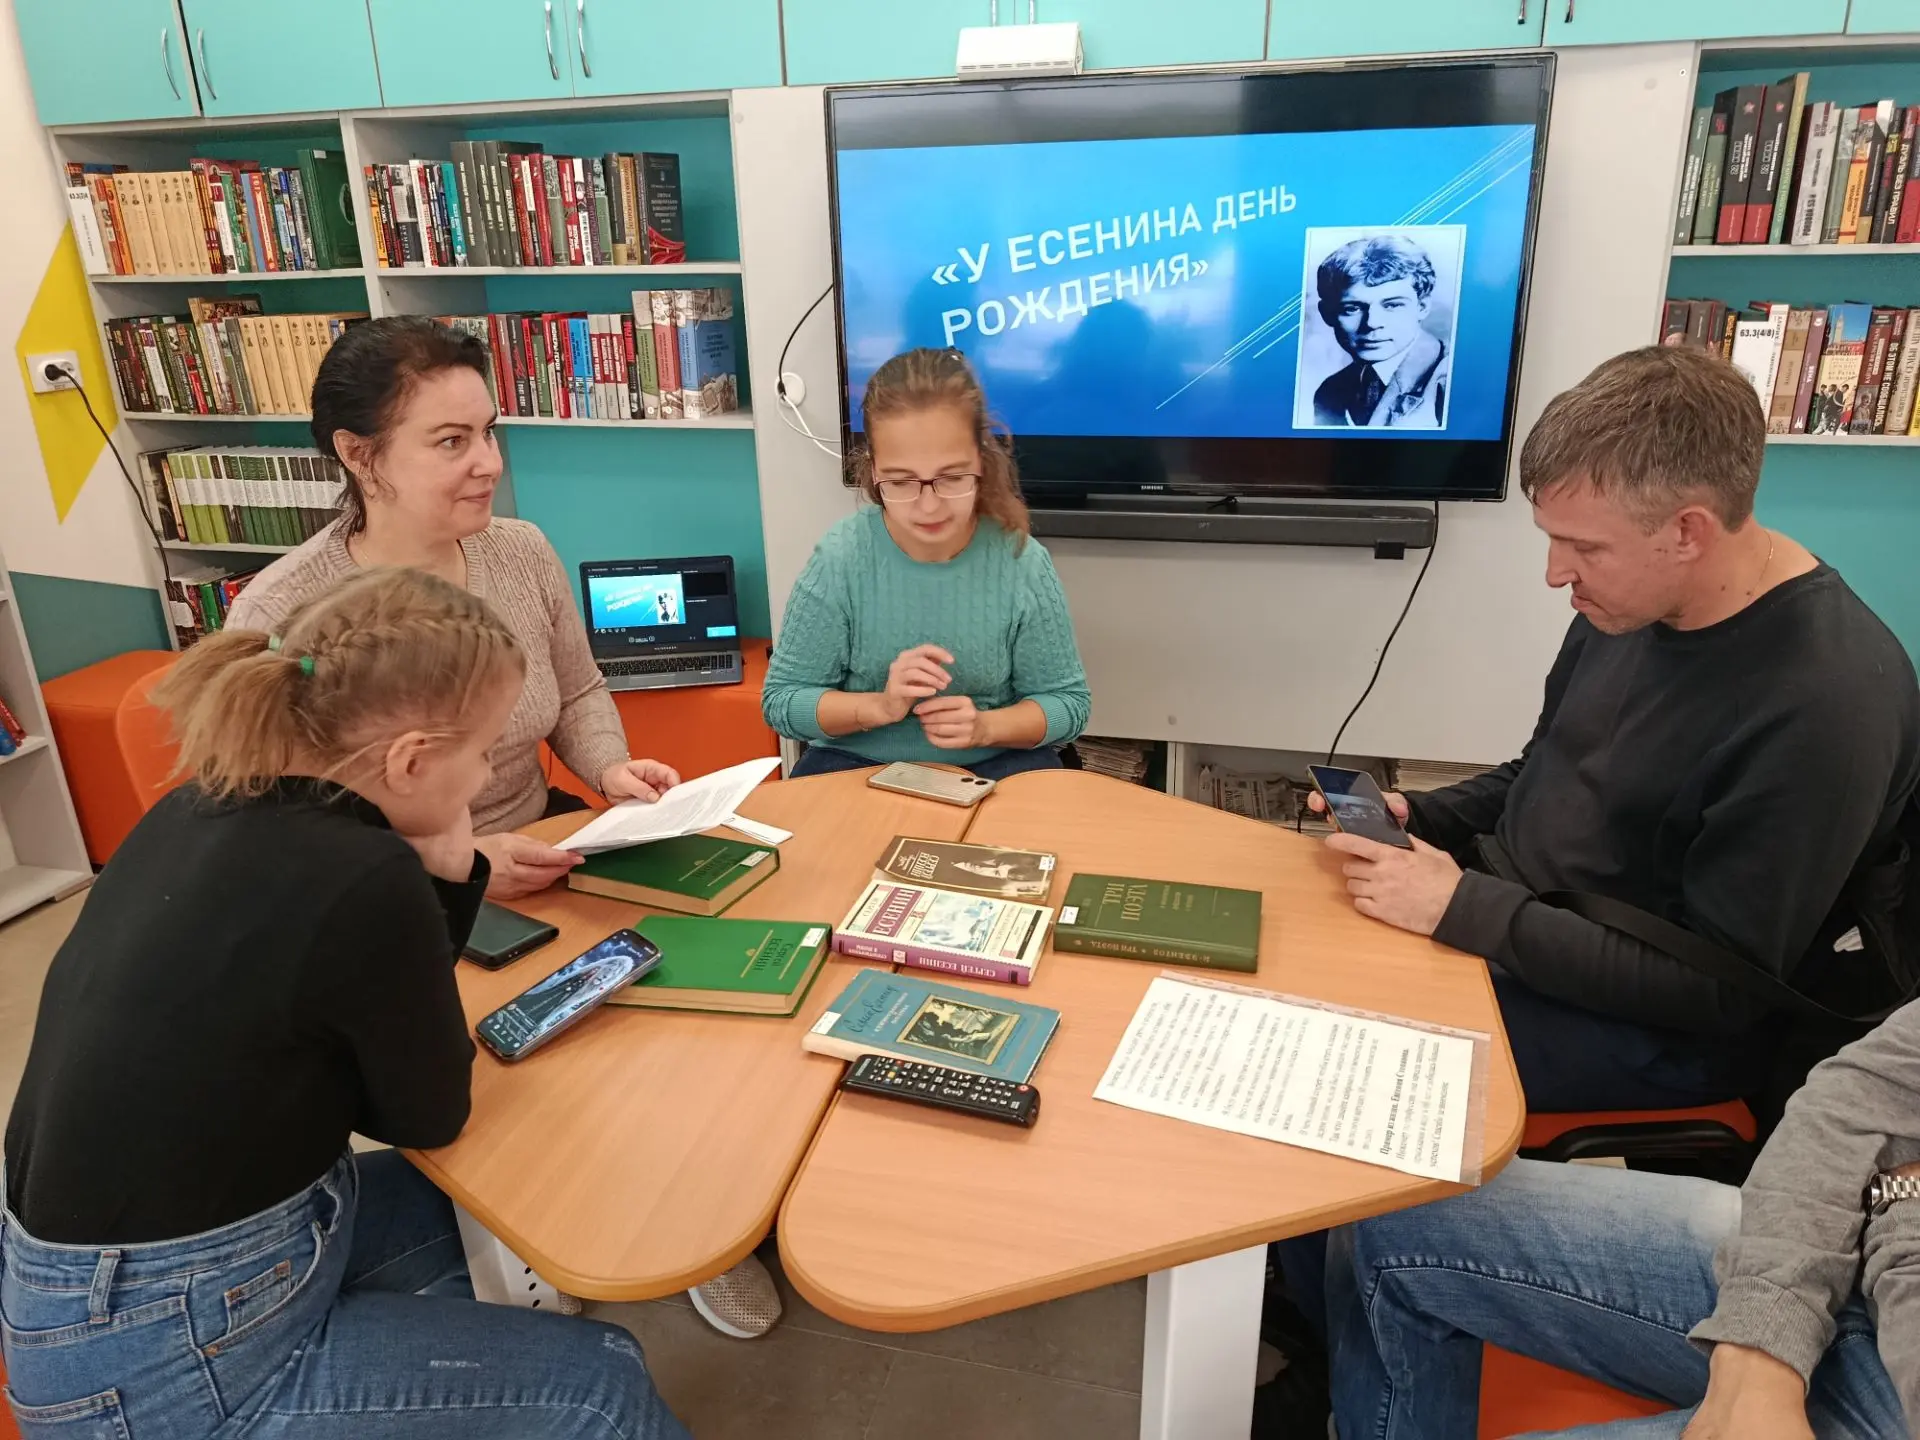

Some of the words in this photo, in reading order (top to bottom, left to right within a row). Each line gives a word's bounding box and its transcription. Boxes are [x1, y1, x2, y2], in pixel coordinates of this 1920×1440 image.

[1896, 143, 1909, 173] ДУЭЛЬ
[1894, 173, 1903, 190] БЕЗ
[1887, 190, 1900, 225] ПРАВИЛ
[932, 243, 990, 286] «У
[1007, 202, 1202, 274] ЕСЕНИНА
[1212, 184, 1297, 235] ДЕНЬ
[941, 252, 1209, 347] РОЖДЕНИЯ»
[1102, 882, 1125, 906] ТРИ
[1121, 884, 1148, 921] ПОЭТА
[873, 888, 917, 936] ЕСЕНИН
[918, 955, 958, 972] ЕСЕНИН
[961, 961, 996, 978] СЕРГЕЙ
